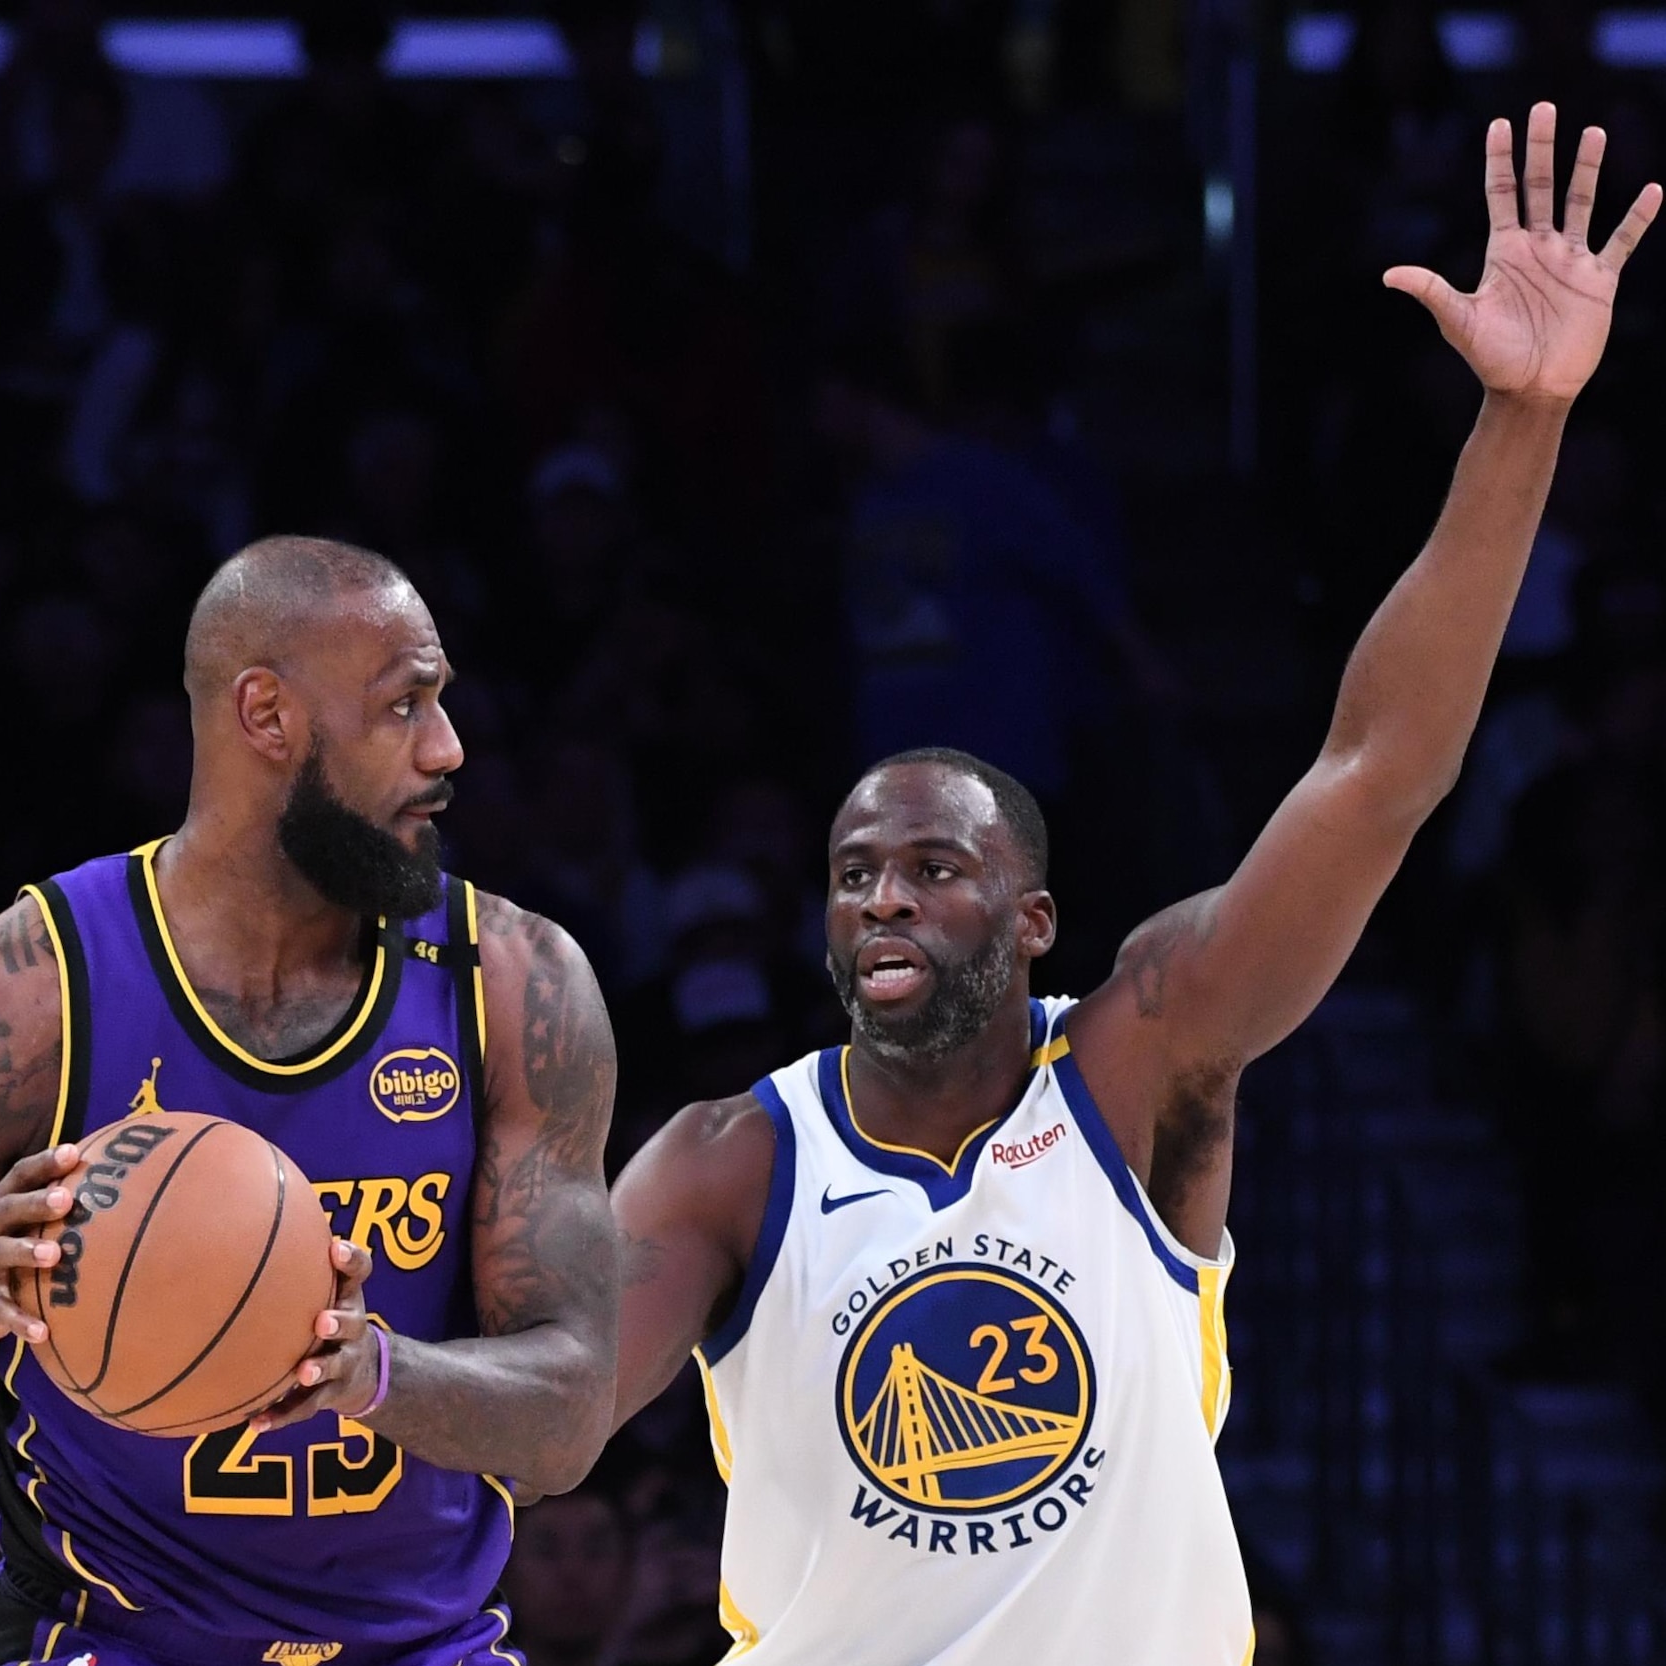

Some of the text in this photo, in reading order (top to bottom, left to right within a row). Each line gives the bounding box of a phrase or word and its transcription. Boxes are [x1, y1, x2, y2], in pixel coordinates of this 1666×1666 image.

[414, 940, 439, 963] 44
[378, 1067, 455, 1099] bibigo
[991, 1123, 1066, 1165] Rakuten
[310, 1172, 451, 1270] ERS
[832, 1234, 1076, 1336] GOLDEN STATE
[969, 1314, 1059, 1394] 23
[850, 1446, 1106, 1555] WARRIORS
